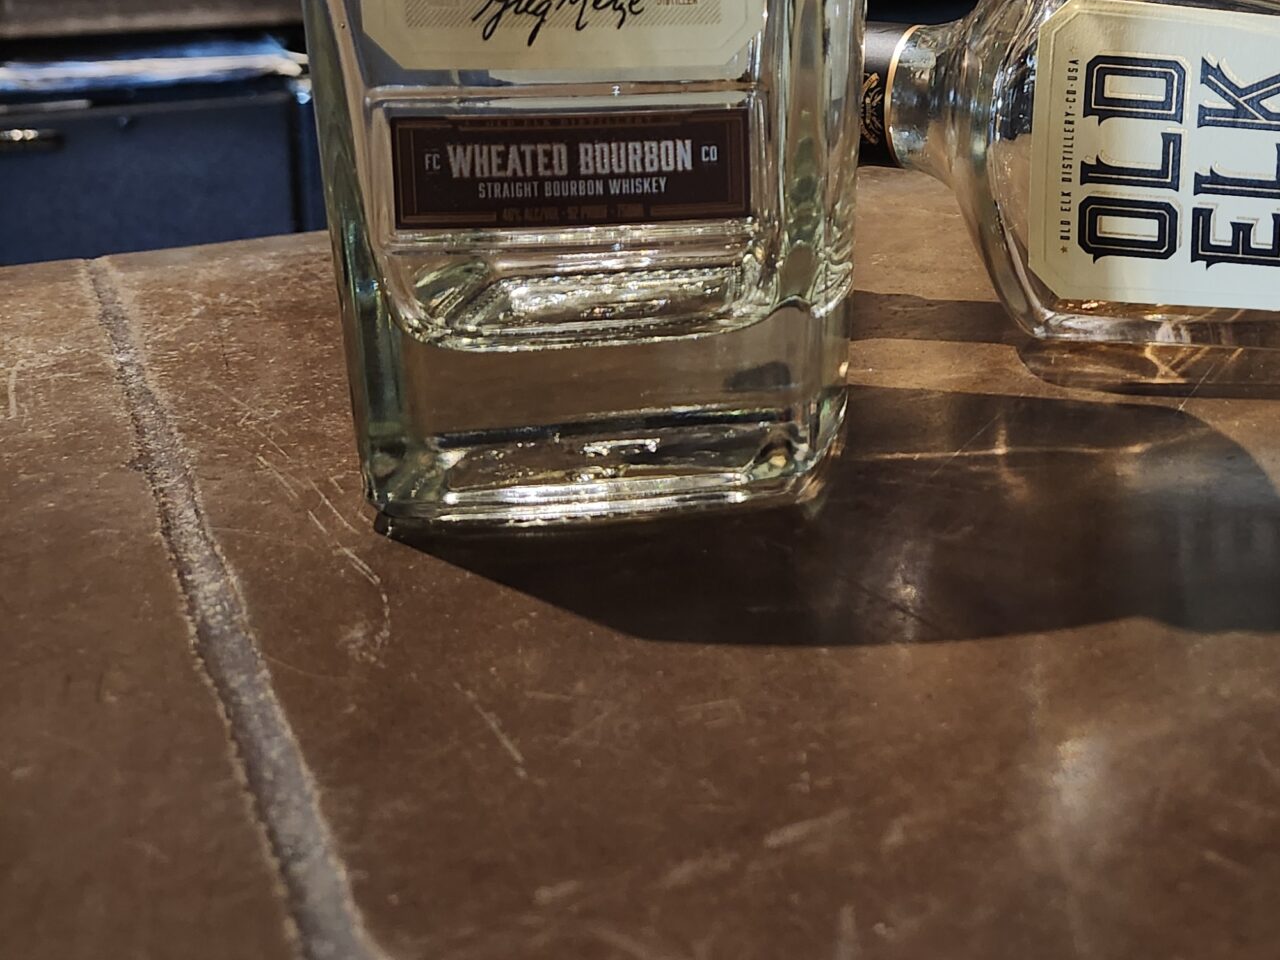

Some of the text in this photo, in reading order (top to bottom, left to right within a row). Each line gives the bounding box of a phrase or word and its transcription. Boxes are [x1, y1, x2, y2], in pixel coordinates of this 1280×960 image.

[424, 152, 441, 171] FC
[446, 143, 568, 179] WHEATED
[578, 139, 694, 176] BOURBON
[1077, 52, 1190, 265] OLD
[478, 176, 668, 200] STRAIGHT BOURBON WHISKEY
[1060, 191, 1072, 213] ELK
[1060, 220, 1072, 241] OLD
